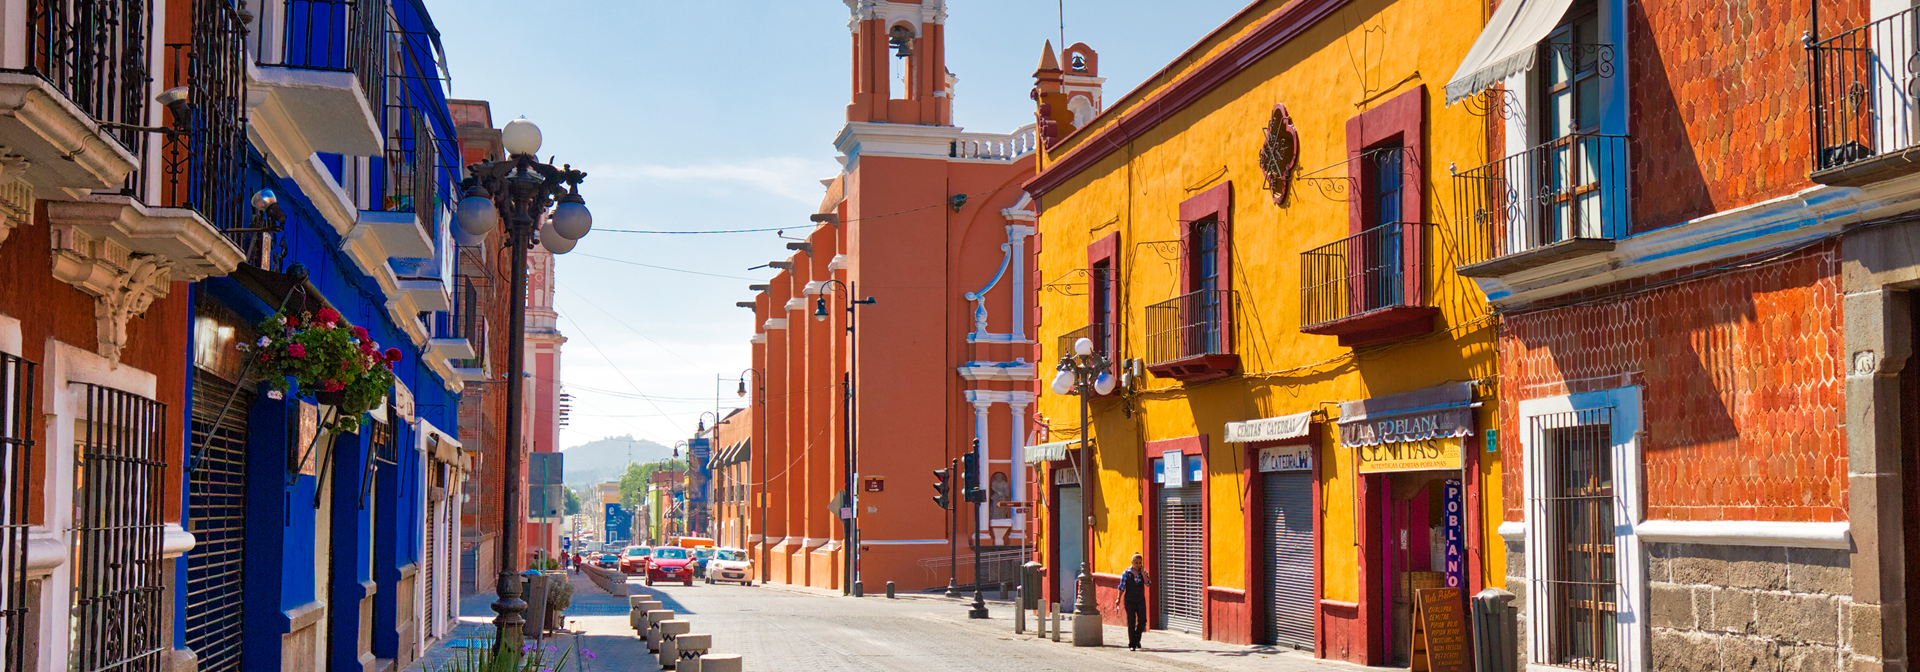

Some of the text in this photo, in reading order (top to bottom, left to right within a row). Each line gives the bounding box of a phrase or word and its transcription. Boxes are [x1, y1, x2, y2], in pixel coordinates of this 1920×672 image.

[1236, 418, 1296, 437] CEMITAS CATEDRAL
[1360, 415, 1439, 438] LA POBLANA
[1361, 438, 1439, 462] CEMITAS
[1271, 453, 1300, 469] CATEDRAL
[1399, 461, 1420, 469] CEMITAS
[1420, 460, 1447, 468] POBLANAS
[1448, 487, 1458, 588] POBLANO
